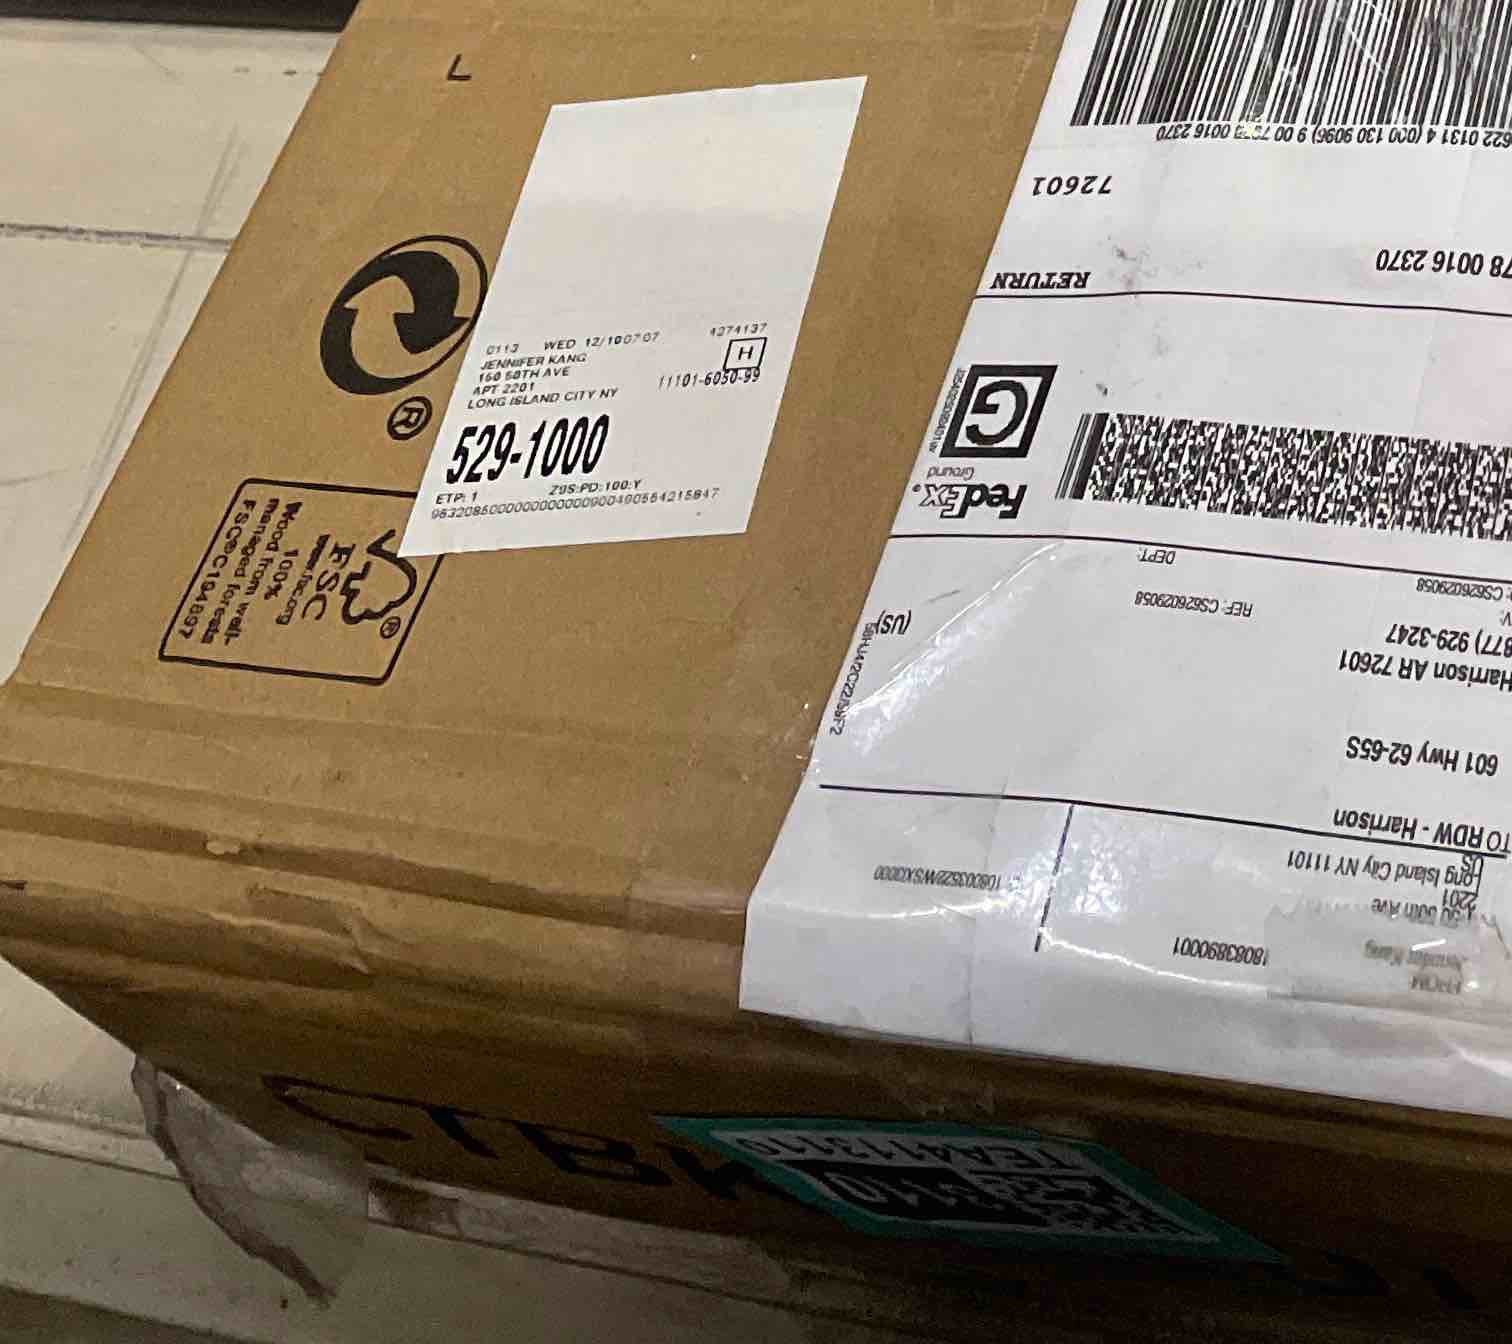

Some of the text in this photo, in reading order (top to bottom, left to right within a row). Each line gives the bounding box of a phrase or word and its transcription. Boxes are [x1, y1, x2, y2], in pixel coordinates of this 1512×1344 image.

[1155, 124, 1193, 142] 2370
[1194, 124, 1232, 141] 0016
[1274, 126, 1295, 143] 00
[1296, 127, 1308, 143] 9
[1357, 127, 1385, 145] 130
[1426, 127, 1438, 145] 4
[1441, 128, 1480, 147] 0131
[1031, 174, 1113, 197] 72601
[1375, 248, 1428, 274] 2370
[1431, 250, 1485, 279] 0016
[990, 271, 1092, 290] RETURN
[544, 338, 577, 351] WED
[738, 346, 754, 361] H
[480, 353, 588, 371] JENNIFER KANG
[542, 366, 571, 378] AVE
[467, 387, 619, 410] LONG ISLAND CITY NY
[472, 382, 536, 396] APT 2201
[965, 379, 1028, 447] G
[446, 414, 611, 485] 529-1000
[926, 466, 975, 481] Ground
[917, 483, 1028, 520] FedEx
[234, 498, 281, 579] managed
[1136, 546, 1177, 566] DEPT:
[244, 556, 269, 596] from
[263, 547, 300, 601] 100%
[301, 542, 357, 622] FSC
[1414, 575, 1504, 602] CS626029058
[1221, 598, 1253, 619] REF:
[875, 609, 913, 637] (US)
[1384, 622, 1471, 654] 929-3247
[1336, 647, 1396, 678] 72601
[1396, 656, 1430, 683] AR
[1344, 734, 1499, 778] 601 Hwy 62-65S
[1331, 807, 1419, 842] Harrison
[1432, 821, 1484, 850] RDW
[1485, 829, 1512, 855] TO
[1286, 849, 1333, 874] 11101
[1332, 855, 1360, 878] NY
[1361, 853, 1393, 882] City
[1394, 861, 1441, 886] Island
[1370, 898, 1402, 921] Ave
